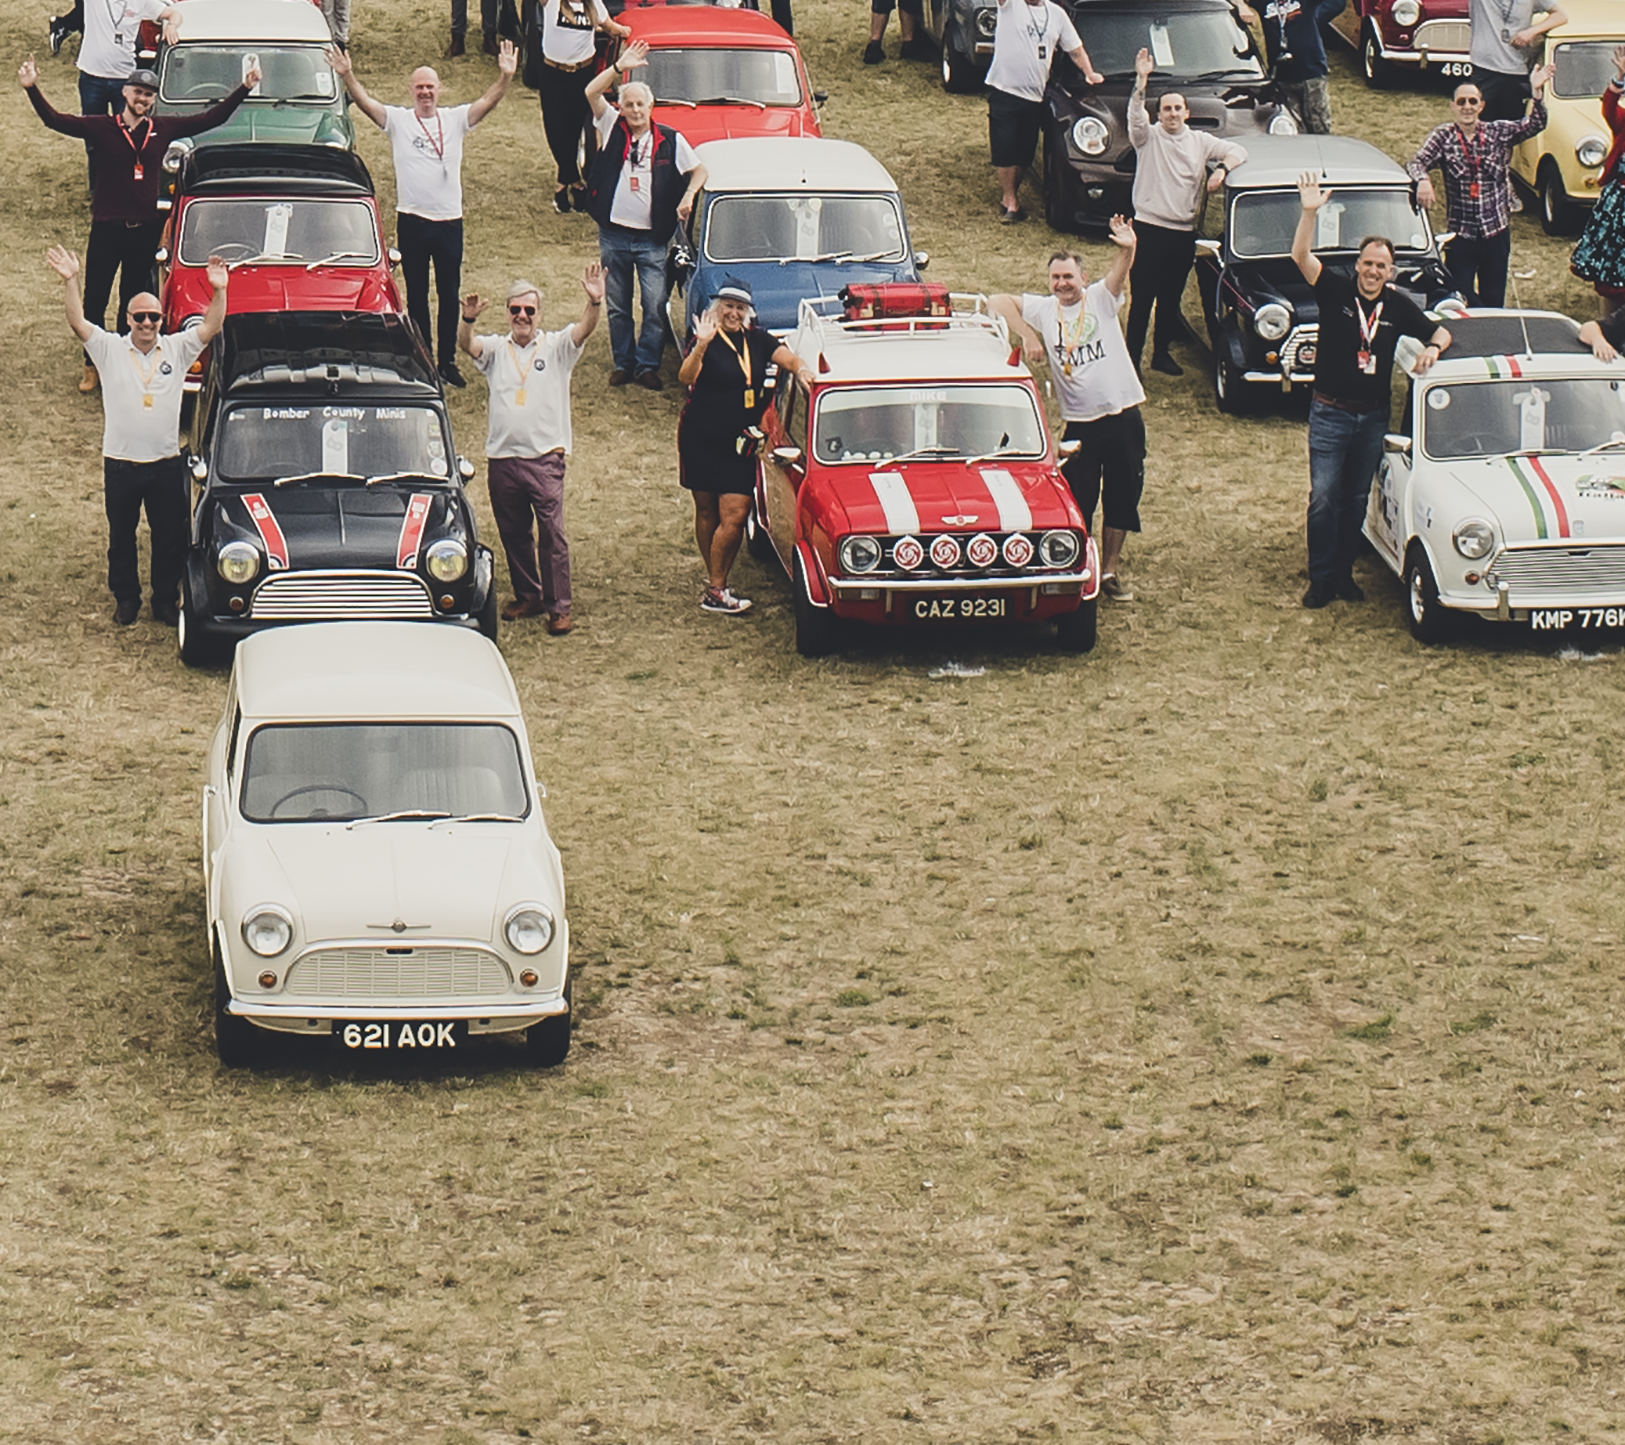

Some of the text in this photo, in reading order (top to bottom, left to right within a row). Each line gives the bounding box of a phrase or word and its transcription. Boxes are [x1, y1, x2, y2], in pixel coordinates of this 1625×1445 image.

[1441, 63, 1473, 76] 460
[263, 406, 406, 420] Bomber County Minis
[915, 599, 1005, 618] CAZ 9231
[1532, 611, 1573, 629] KMP
[343, 1022, 456, 1049] 621 AOK
